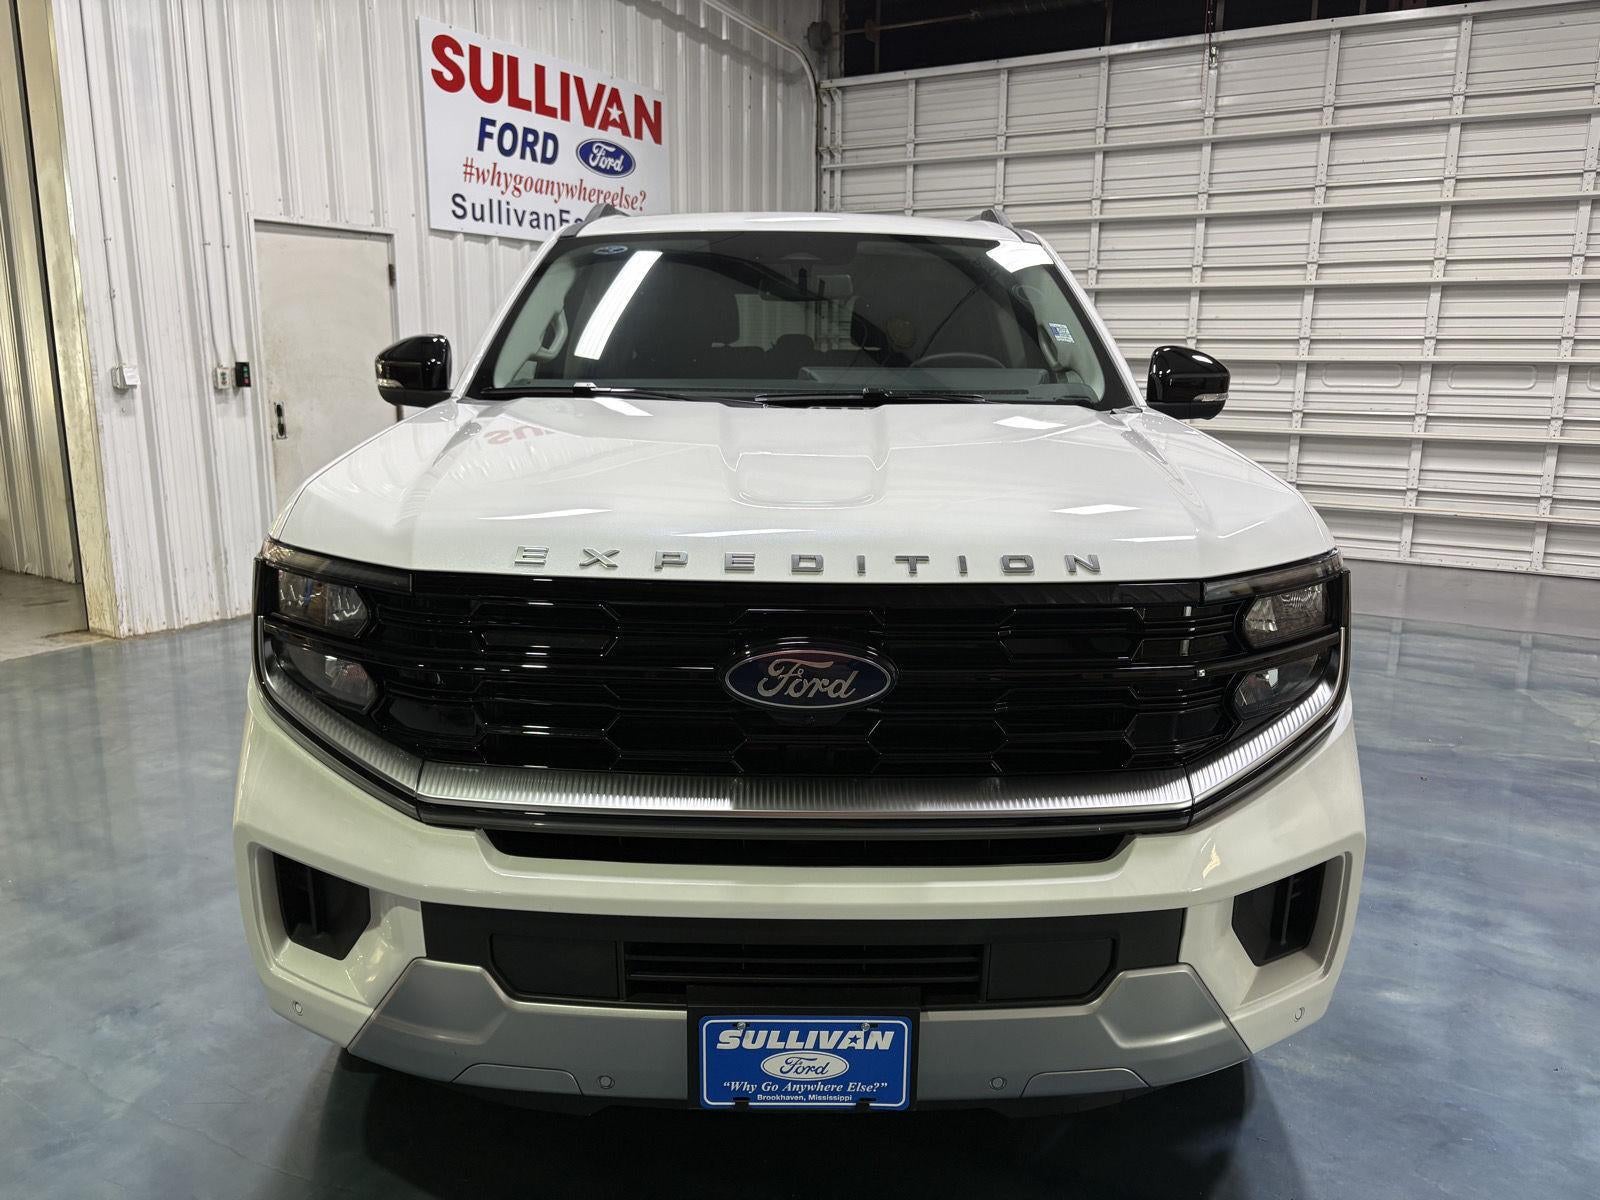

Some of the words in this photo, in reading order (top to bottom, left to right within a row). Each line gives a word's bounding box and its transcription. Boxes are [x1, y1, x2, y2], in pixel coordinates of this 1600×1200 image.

[431, 34, 662, 145] SULLIVAN
[477, 116, 559, 165] FORD
[589, 142, 624, 172] Ford
[463, 156, 647, 212] #whygoanywhereelse?
[514, 544, 1101, 575] EXPEDITION
[756, 658, 859, 700] Ford
[716, 1029, 895, 1050] SULLIVAN
[779, 1056, 830, 1075] Ford
[757, 1094, 807, 1102] Brookhaven,
[808, 1094, 853, 1102] Mississippi
[761, 1081, 779, 1092] Go
[782, 1082, 844, 1093] Anywhere
